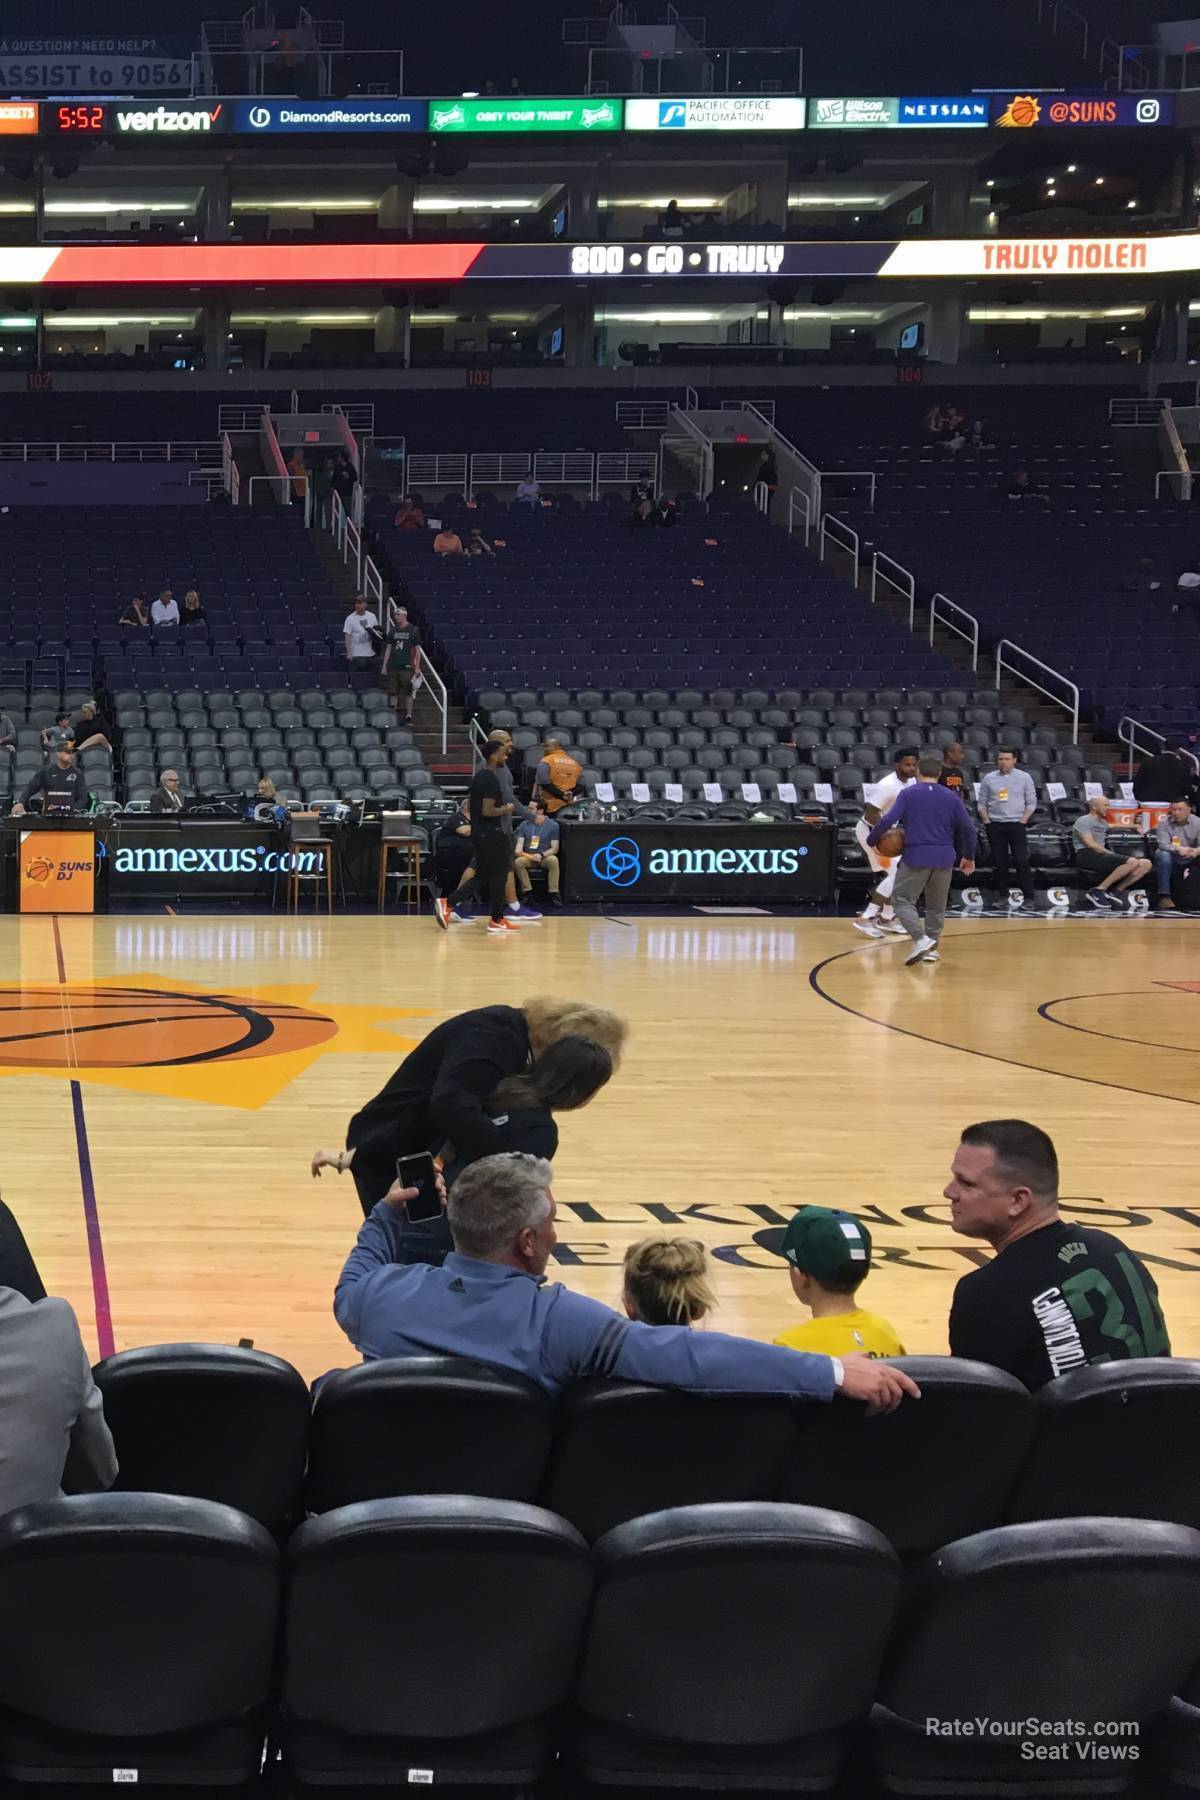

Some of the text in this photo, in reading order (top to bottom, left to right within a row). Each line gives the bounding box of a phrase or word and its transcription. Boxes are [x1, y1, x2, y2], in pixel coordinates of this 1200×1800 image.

[0, 40, 9, 51] A
[11, 40, 80, 51] QUESTION?
[82, 40, 115, 50] NEED
[118, 39, 156, 50] HELP?
[89, 65, 113, 85] to
[689, 100, 772, 110] PACIFIC OFFICE
[846, 100, 883, 112] Wilson
[904, 103, 985, 117] NETSIAN
[59, 107, 103, 128] 5:52
[280, 110, 411, 123] DiamondResorts.com
[476, 110, 574, 122] OBEY YOUR THIRST
[689, 112, 765, 122] AUTOMATION
[845, 110, 891, 122] Electric
[1049, 101, 1116, 123] @SUNS
[117, 107, 210, 131] verizon
[571, 245, 785, 274] 800 GO TRULY
[983, 243, 1148, 269] TRULY NOLEN
[28, 373, 50, 388] 102
[469, 370, 490, 385] 103
[58, 862, 93, 871] SUNS
[56, 871, 73, 881] DJ
